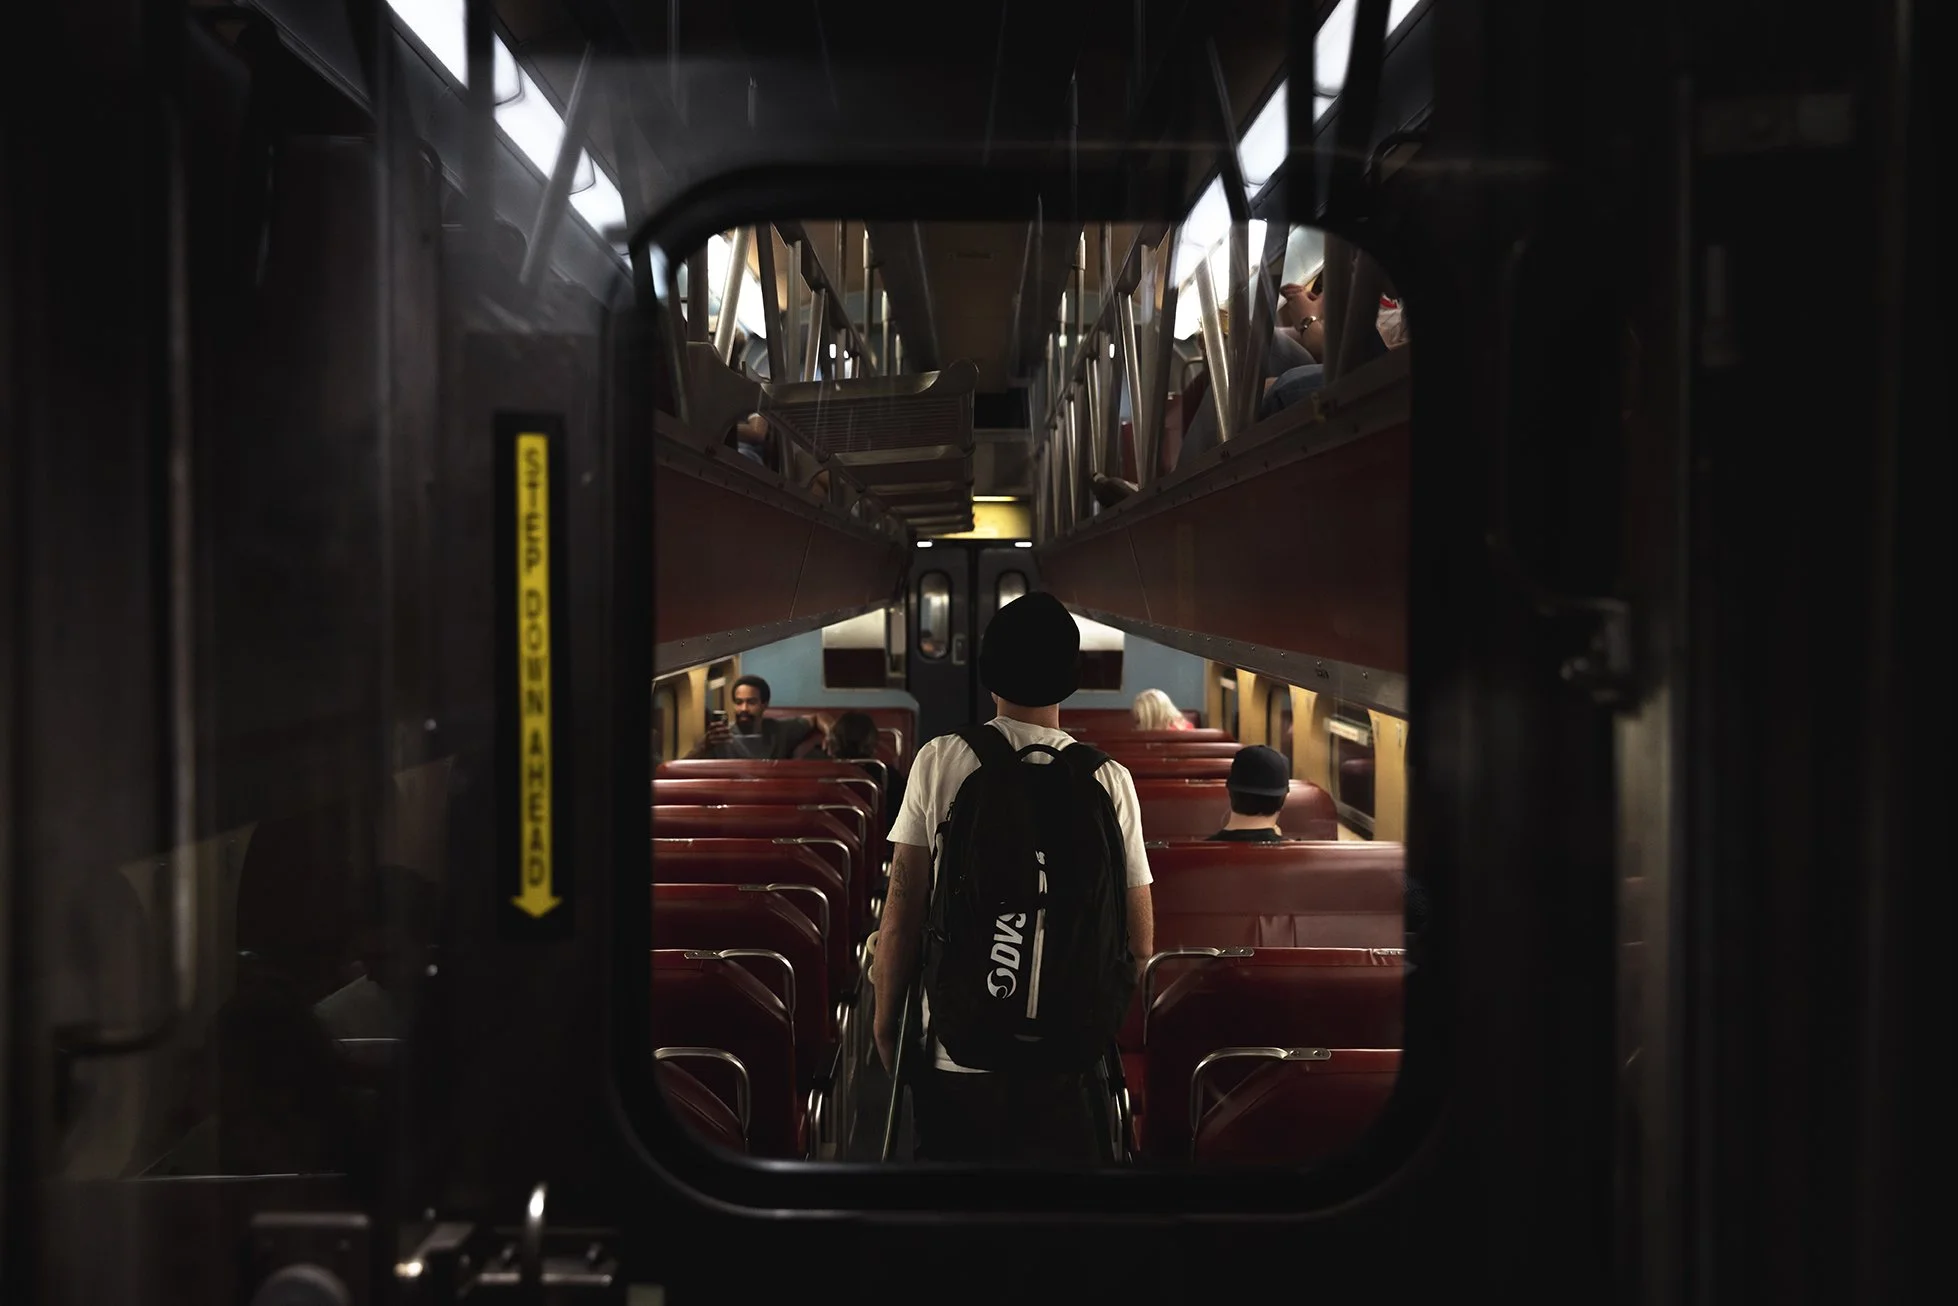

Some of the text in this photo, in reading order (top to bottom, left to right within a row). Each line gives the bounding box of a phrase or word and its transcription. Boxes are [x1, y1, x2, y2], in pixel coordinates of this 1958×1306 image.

[525, 447, 545, 887] STEP DOWN AHEAD
